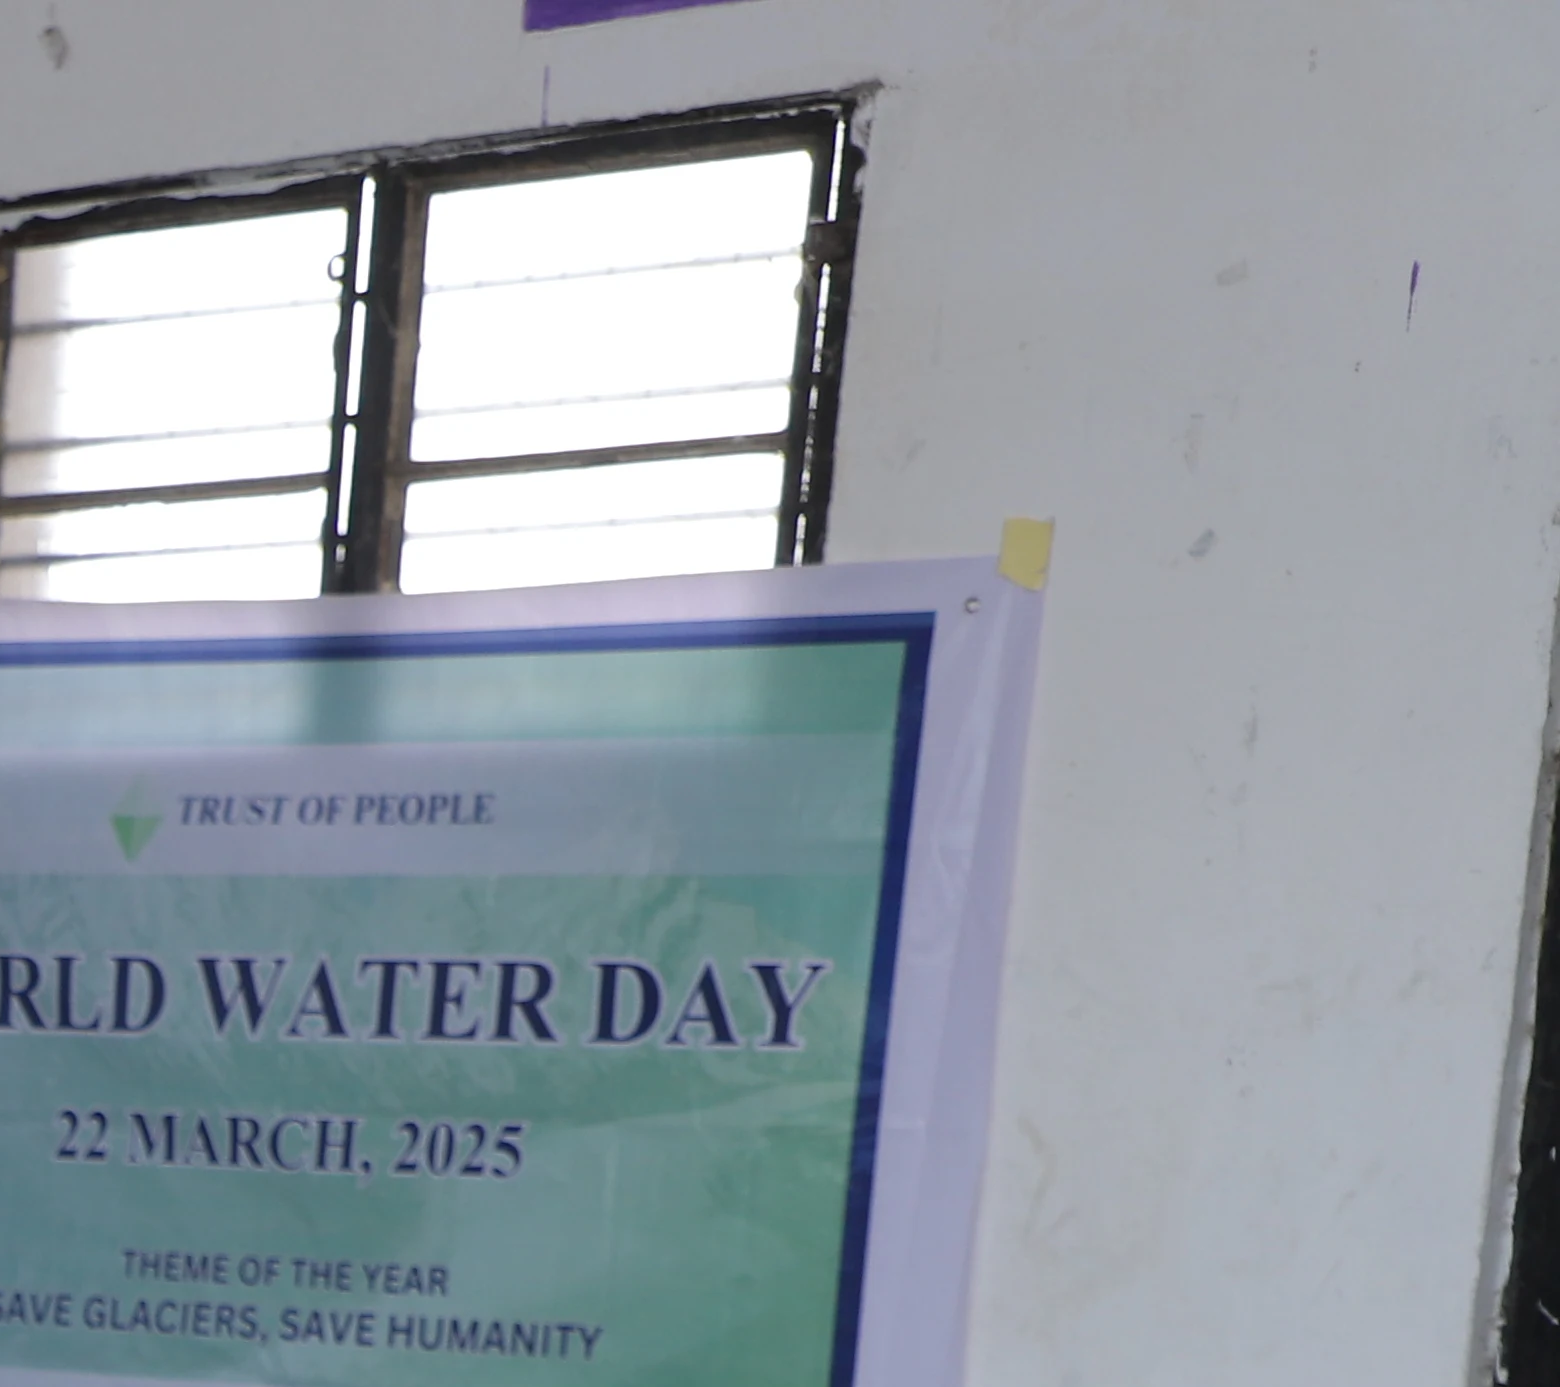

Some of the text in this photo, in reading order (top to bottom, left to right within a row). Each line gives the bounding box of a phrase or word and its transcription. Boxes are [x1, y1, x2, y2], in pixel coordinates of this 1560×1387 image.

[179, 792, 496, 827] TRUST OF PEOPLE
[196, 956, 560, 1044] WATER
[587, 959, 830, 1049] DAY
[56, 1108, 524, 1179] 22 MARCH, 2025
[121, 1249, 451, 1296] THEME OF THE YEAR
[83, 1295, 271, 1345] GLACIERS,
[279, 1307, 376, 1348] SAVE
[385, 1314, 603, 1361] HUMANITY
